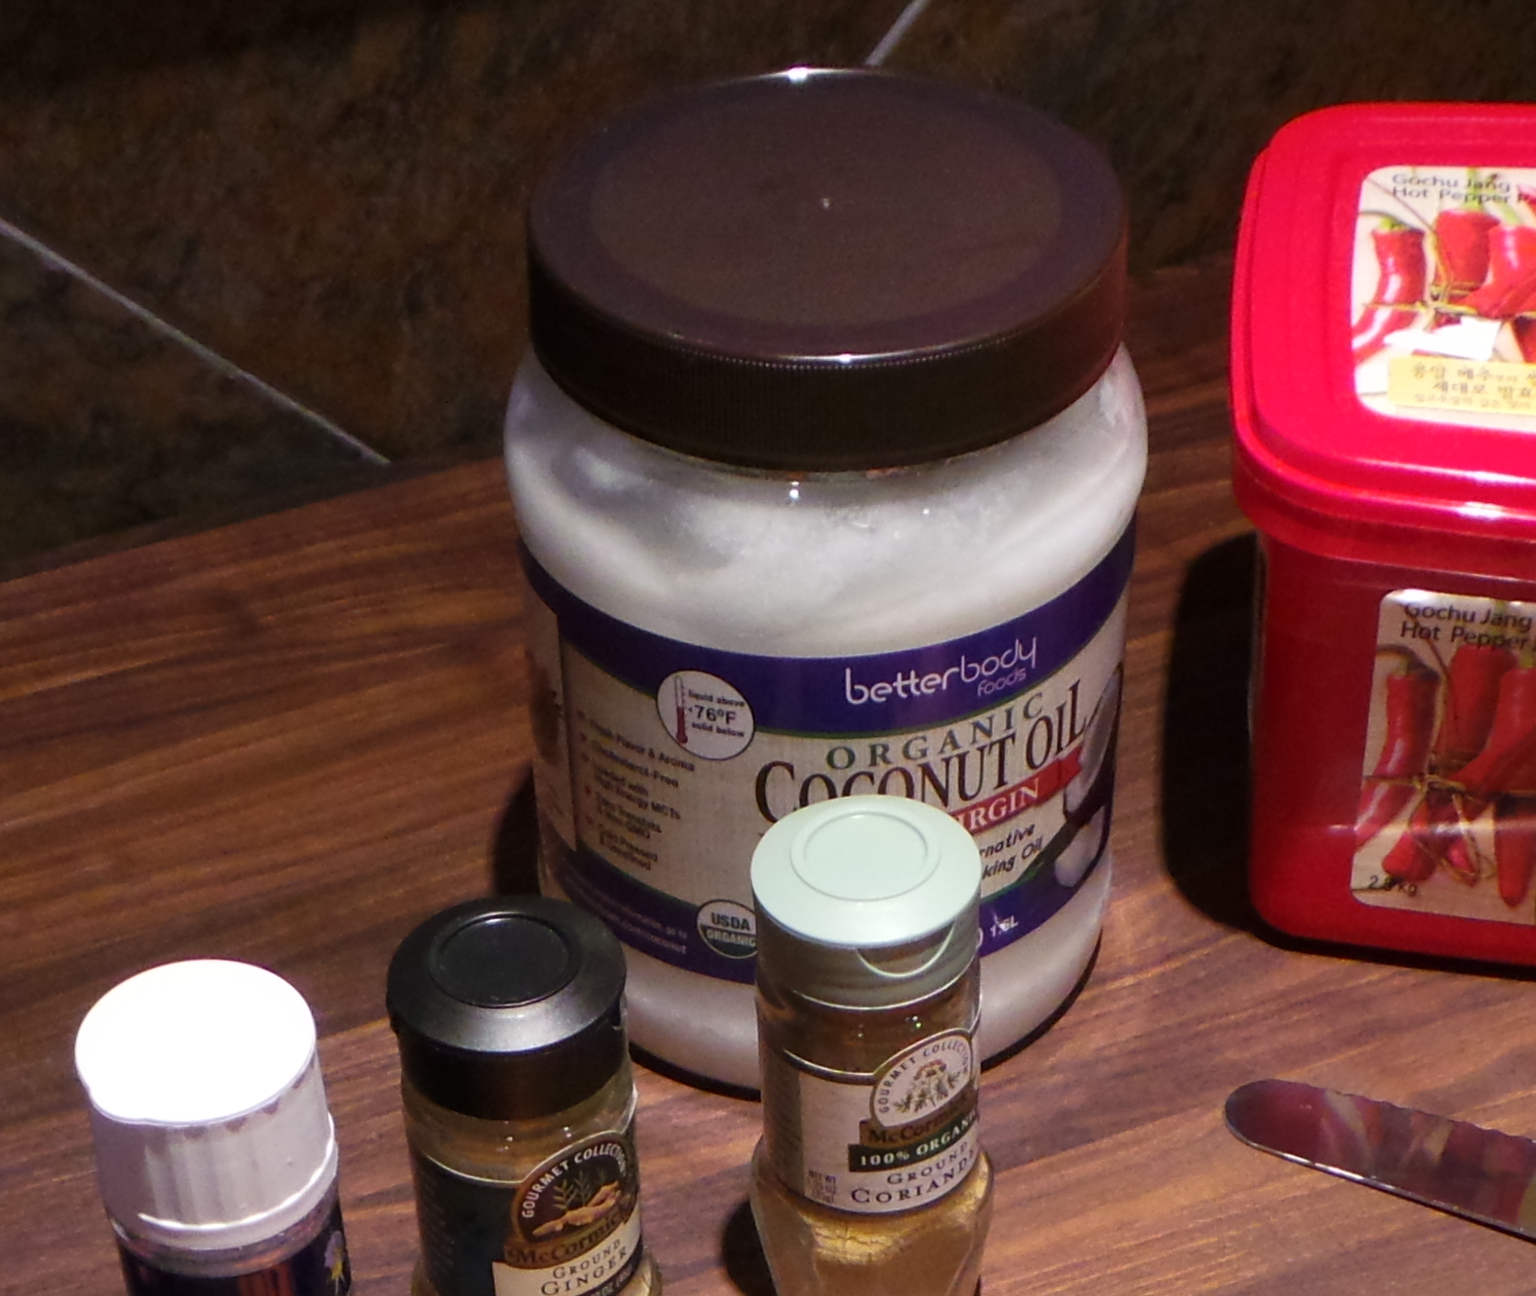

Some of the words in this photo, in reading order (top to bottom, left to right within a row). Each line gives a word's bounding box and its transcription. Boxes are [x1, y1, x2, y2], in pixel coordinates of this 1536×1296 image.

[1392, 173, 1461, 188] Gochu
[1464, 175, 1512, 192] Jang
[1392, 187, 1430, 200] Hot
[1438, 188, 1514, 205] Pepper
[1400, 621, 1442, 640] Hot
[1450, 625, 1530, 650] Pepper
[1403, 603, 1477, 623] Gochu
[1479, 608, 1534, 633] Jang
[845, 637, 1037, 706] betterbody
[978, 667, 1027, 697] foods
[688, 689, 713, 703] liquid
[716, 694, 746, 708] above
[716, 725, 745, 738] below
[826, 692, 1043, 771] ORGANIC
[1025, 678, 1087, 771] OIL
[956, 777, 1040, 831] IRGIN
[979, 823, 1036, 859] rnative
[982, 854, 1017, 880] king
[1021, 836, 1044, 860] Oil
[710, 911, 751, 931] USDA
[877, 1056, 916, 1114] GOURMET
[860, 1151, 910, 1168] 100%
[886, 1141, 968, 1186] GROUND
[521, 1160, 569, 1219] GOURMET
[540, 1246, 628, 1296] GINGER
[552, 1239, 621, 1279] GROUND
